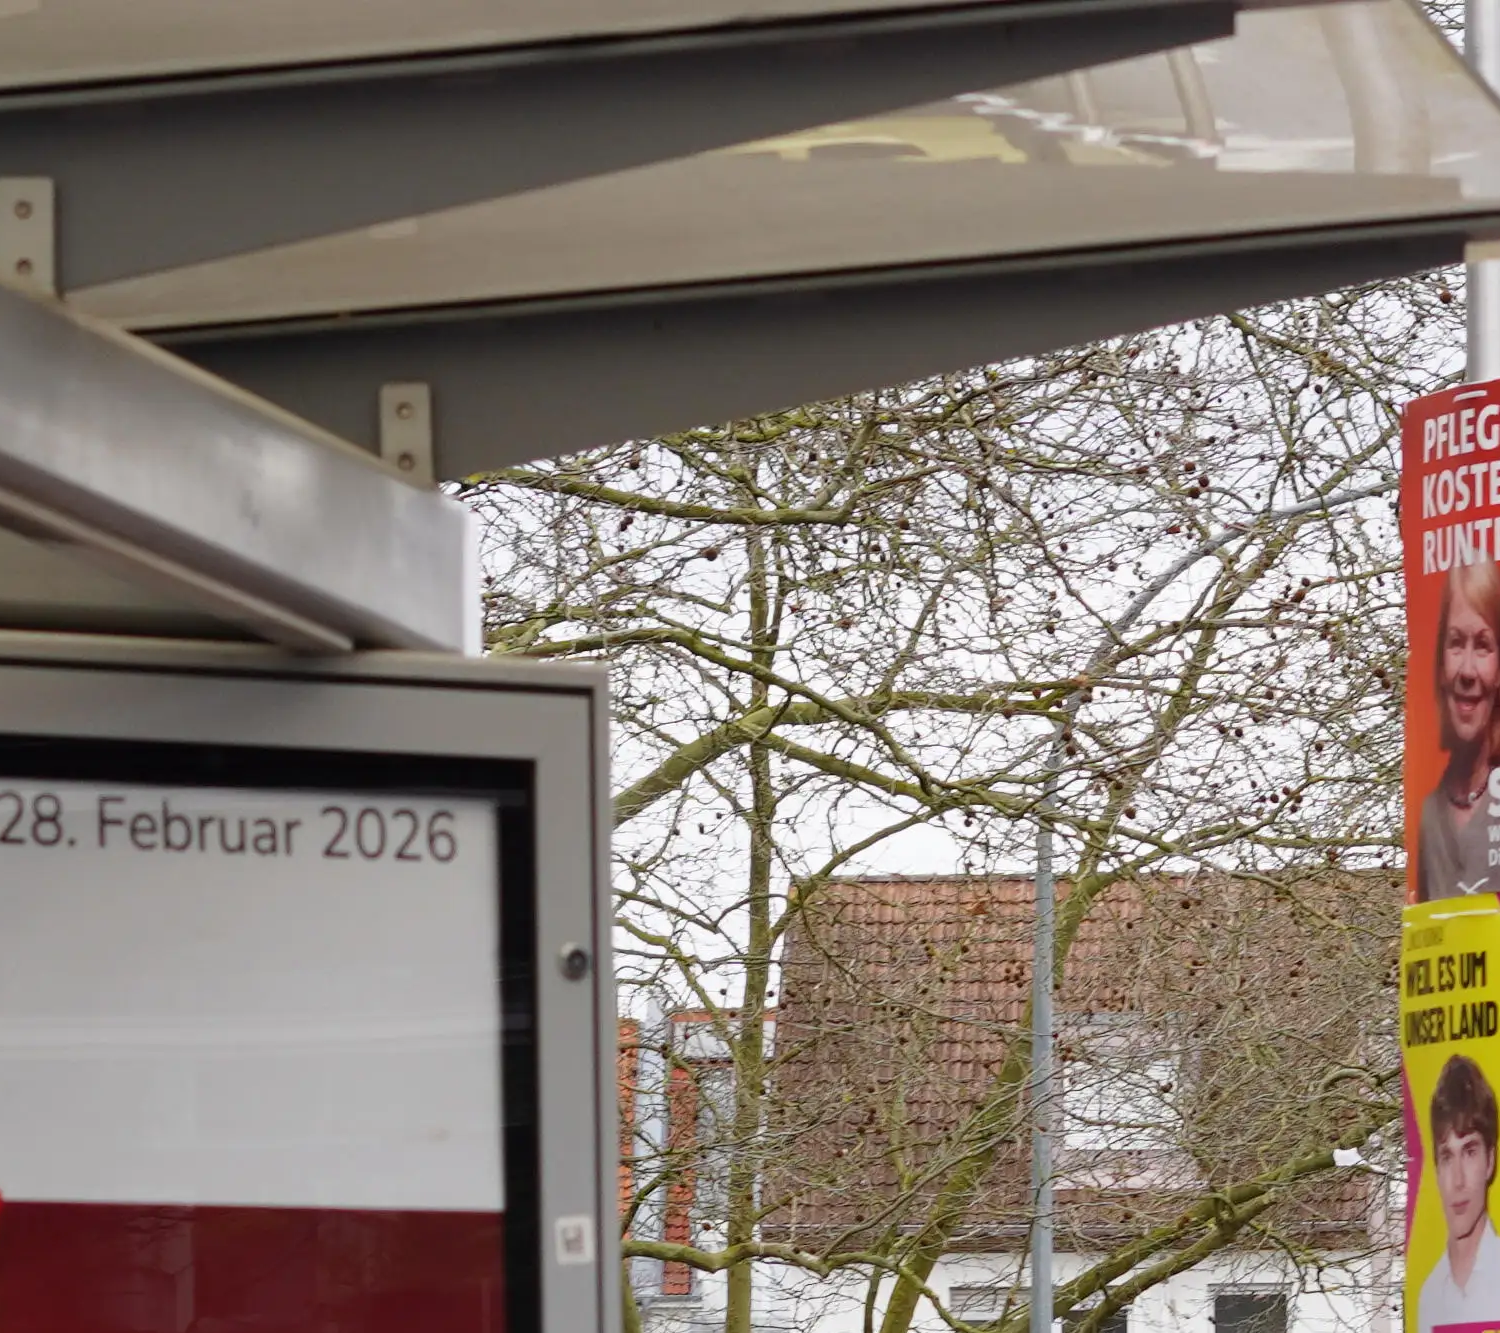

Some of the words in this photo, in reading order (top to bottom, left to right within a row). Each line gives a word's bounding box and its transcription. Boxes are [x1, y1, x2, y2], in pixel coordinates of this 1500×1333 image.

[97, 796, 300, 859] Februar
[320, 805, 458, 864] 2026
[1405, 958, 1434, 998] WEIL
[1438, 954, 1456, 992] ES
[1459, 950, 1487, 989] UM
[1405, 1006, 1446, 1048] UNSER
[1449, 1000, 1498, 1041] LAND
